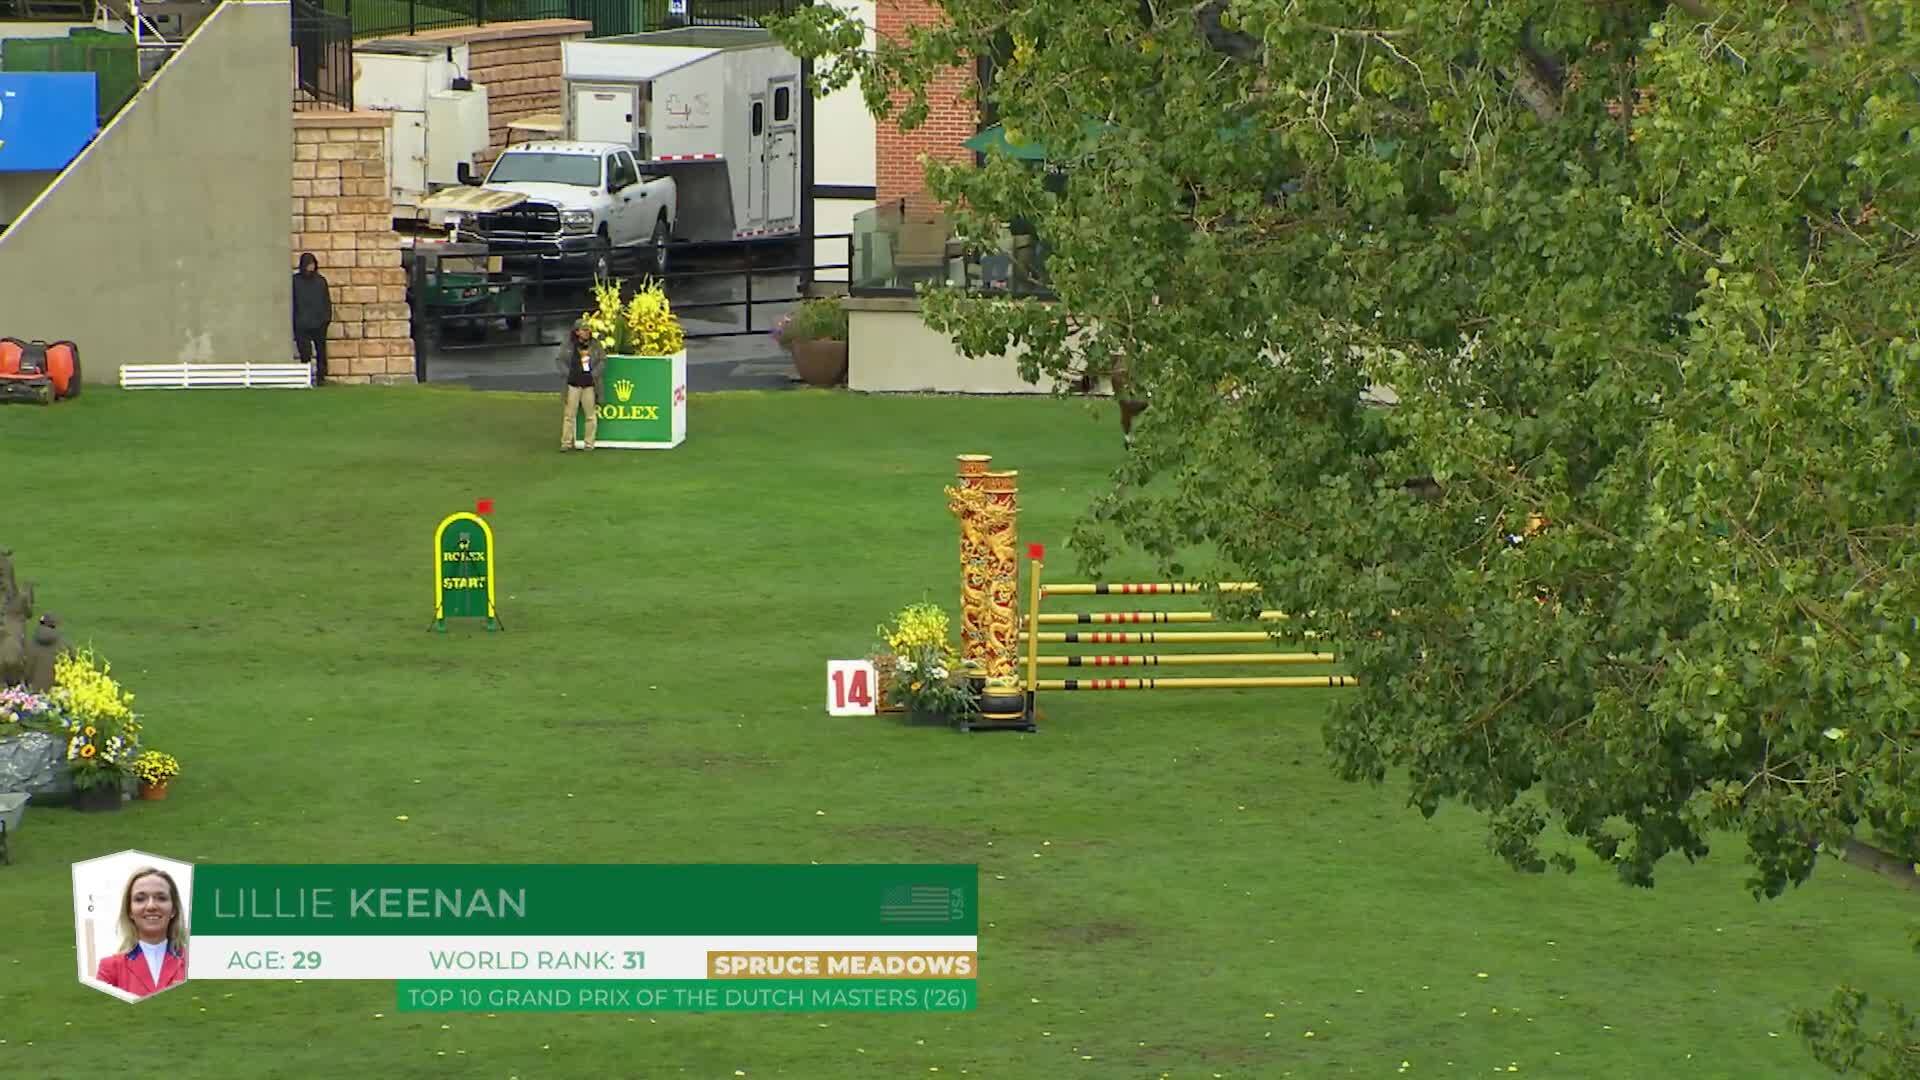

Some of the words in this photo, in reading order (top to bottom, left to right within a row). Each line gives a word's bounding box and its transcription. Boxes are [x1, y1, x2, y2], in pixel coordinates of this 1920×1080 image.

[594, 404, 659, 420] ROLEX
[443, 577, 485, 590] START
[832, 670, 872, 708] 14
